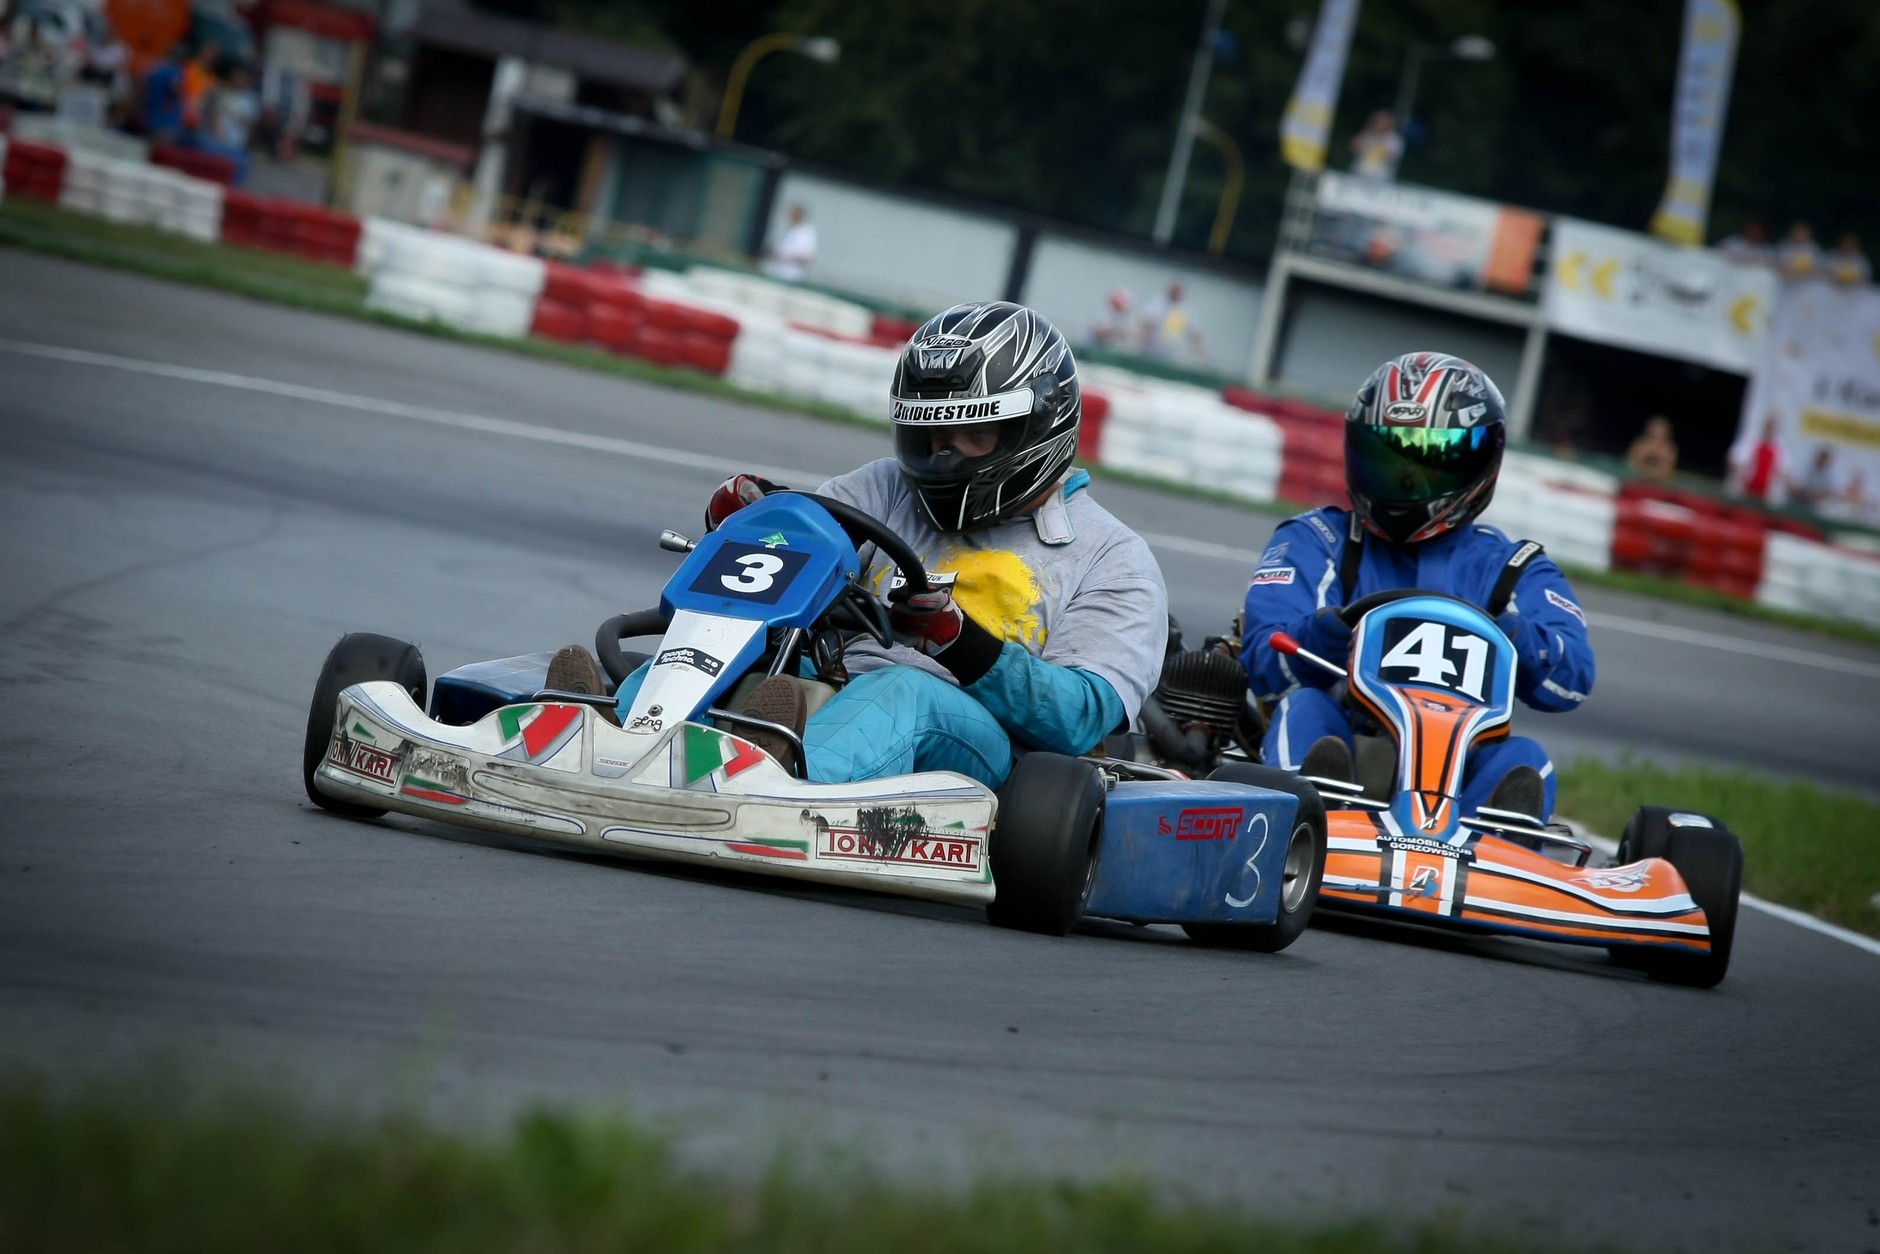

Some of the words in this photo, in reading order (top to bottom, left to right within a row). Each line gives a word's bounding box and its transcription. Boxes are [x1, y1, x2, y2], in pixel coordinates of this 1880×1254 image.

[919, 334, 968, 348] Nitro
[894, 400, 1001, 421] BRIDGESTONE
[720, 553, 784, 593] 3
[1381, 622, 1489, 702] 41
[354, 748, 397, 778] KART
[1178, 811, 1242, 838] SCOTT
[911, 838, 976, 863] KART
[1376, 835, 1472, 855] AUTOMOBILKLUB
[1390, 842, 1460, 858] GORZOWSKI
[1225, 812, 1268, 908] 3
